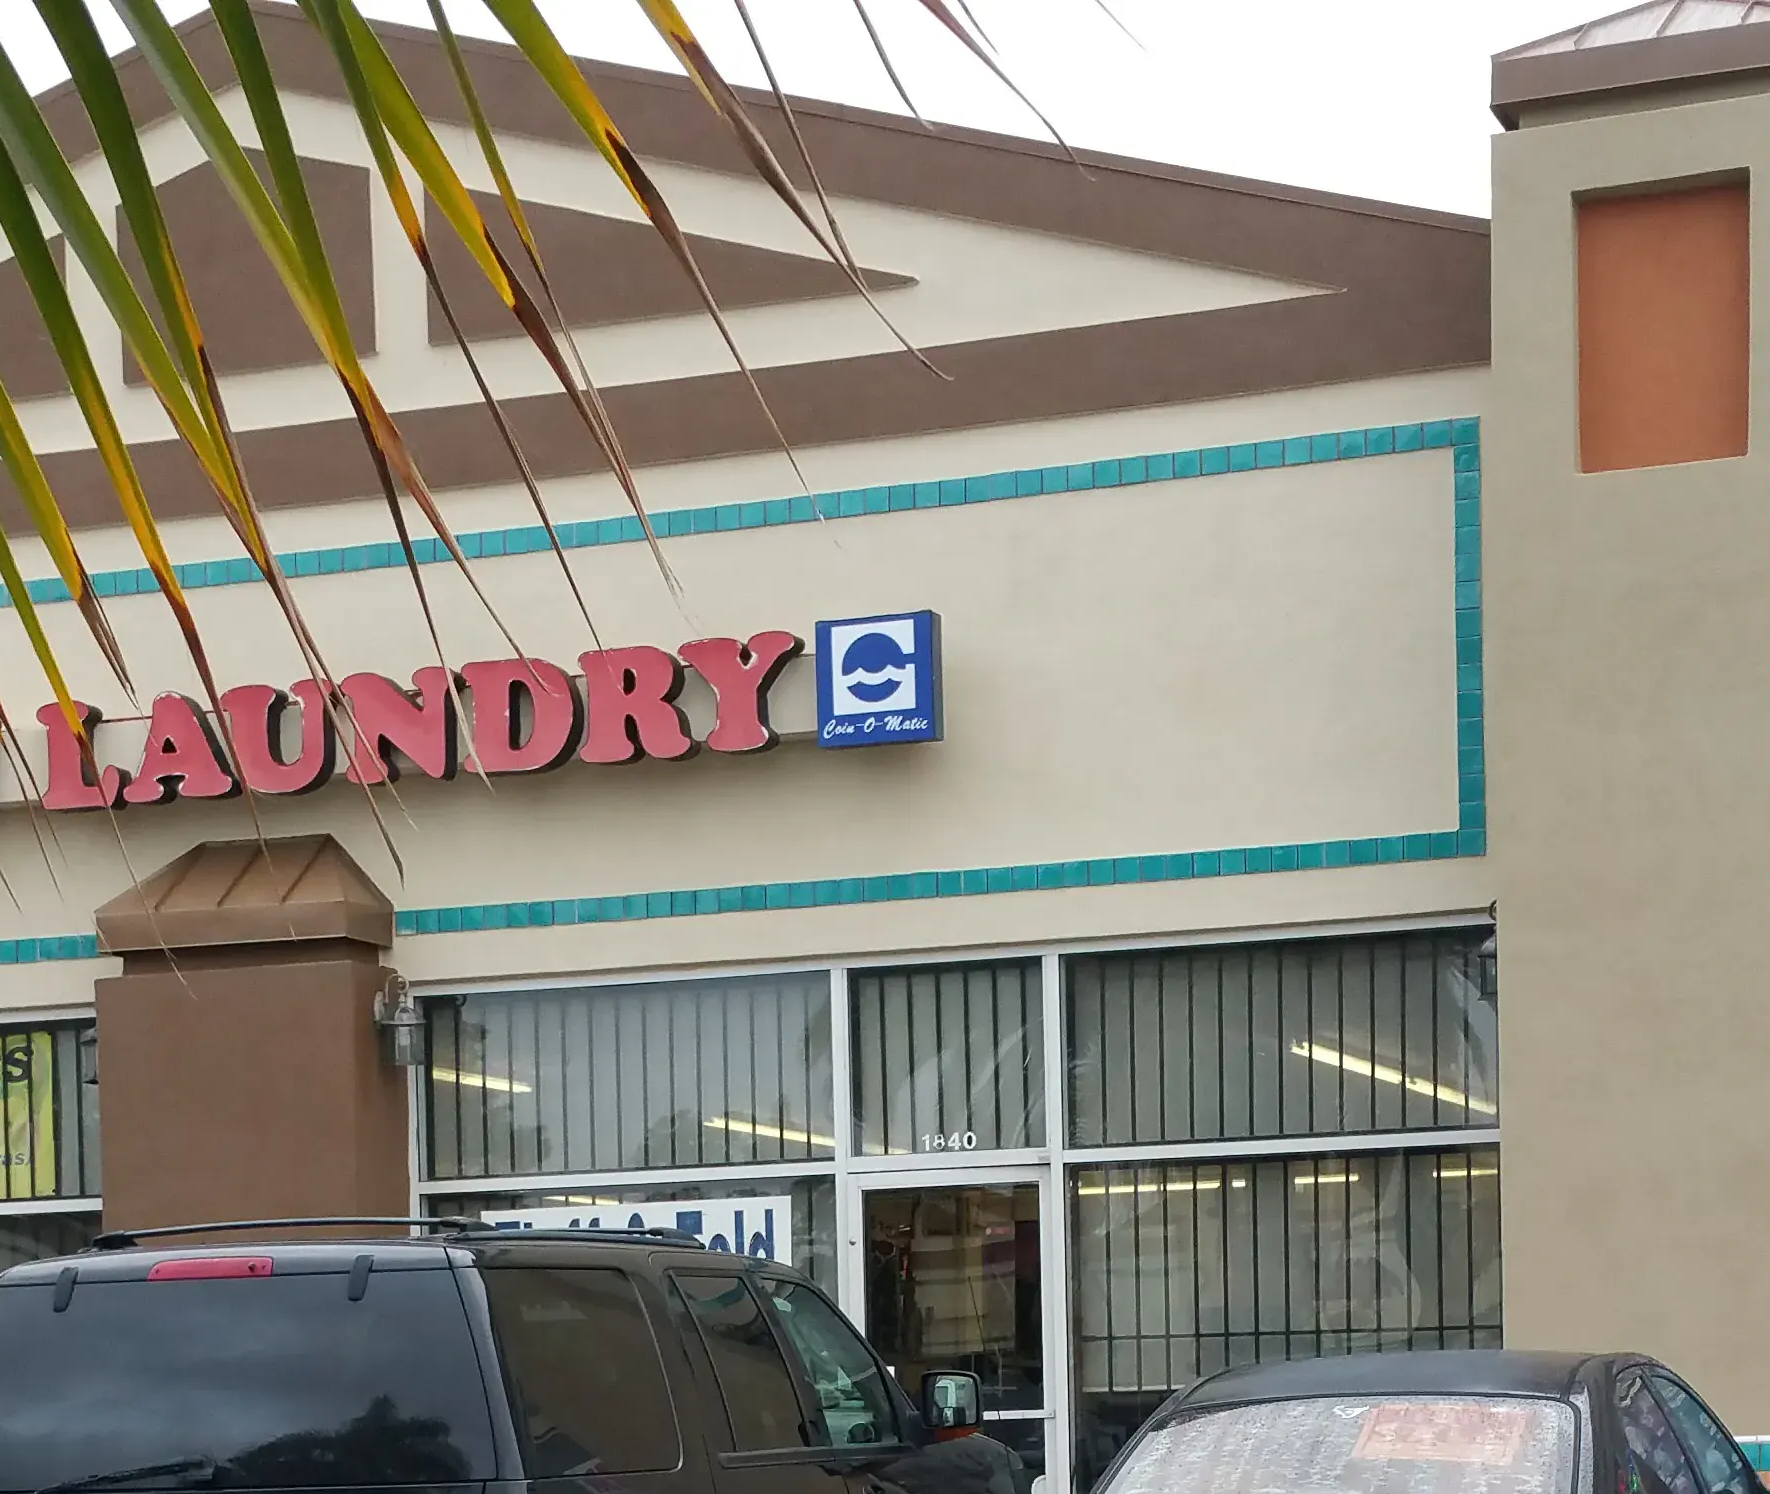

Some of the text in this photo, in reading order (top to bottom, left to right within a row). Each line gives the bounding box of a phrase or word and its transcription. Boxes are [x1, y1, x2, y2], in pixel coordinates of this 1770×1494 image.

[41, 630, 803, 811] LAUNDRY
[823, 715, 929, 739] Coin-O-Matic
[921, 1131, 977, 1151] 1840
